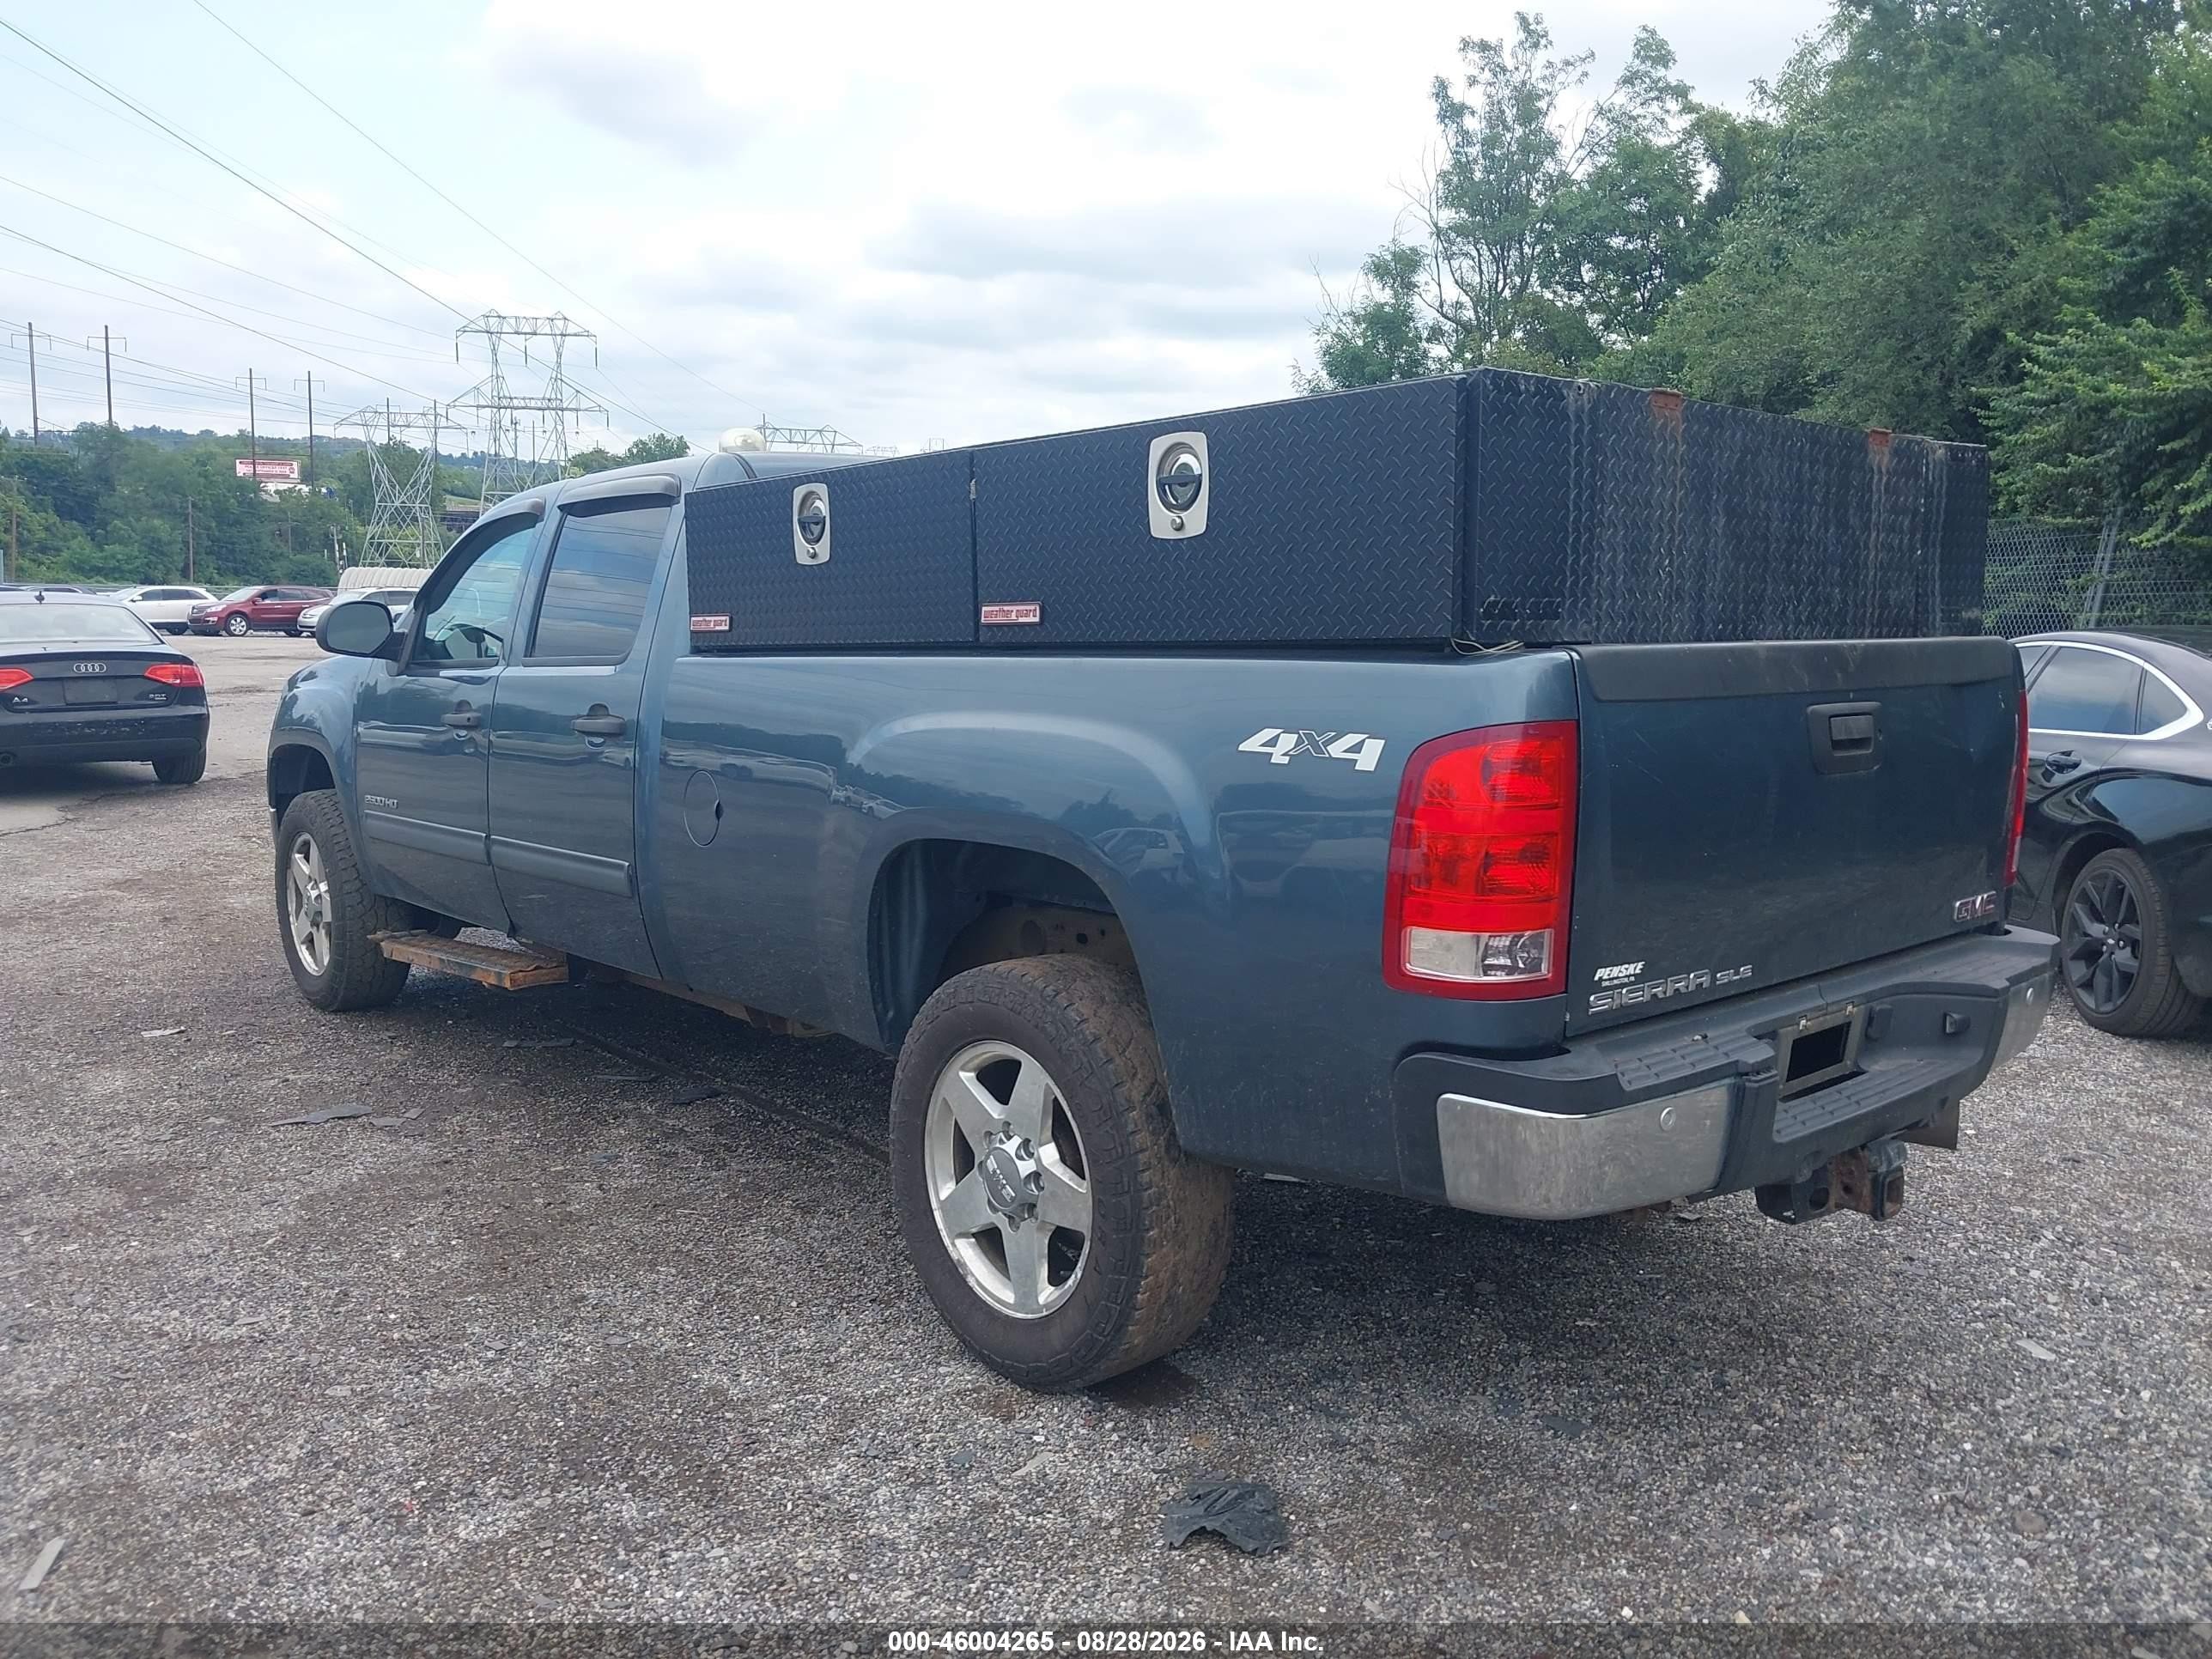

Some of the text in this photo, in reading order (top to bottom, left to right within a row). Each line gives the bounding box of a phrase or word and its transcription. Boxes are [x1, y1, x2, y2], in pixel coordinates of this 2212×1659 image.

[983, 605, 1037, 620] weather guard
[1954, 890, 1996, 921] GMC
[1594, 961, 1645, 981] PENSKE
[1589, 964, 1753, 1015] SIERRA SLE
